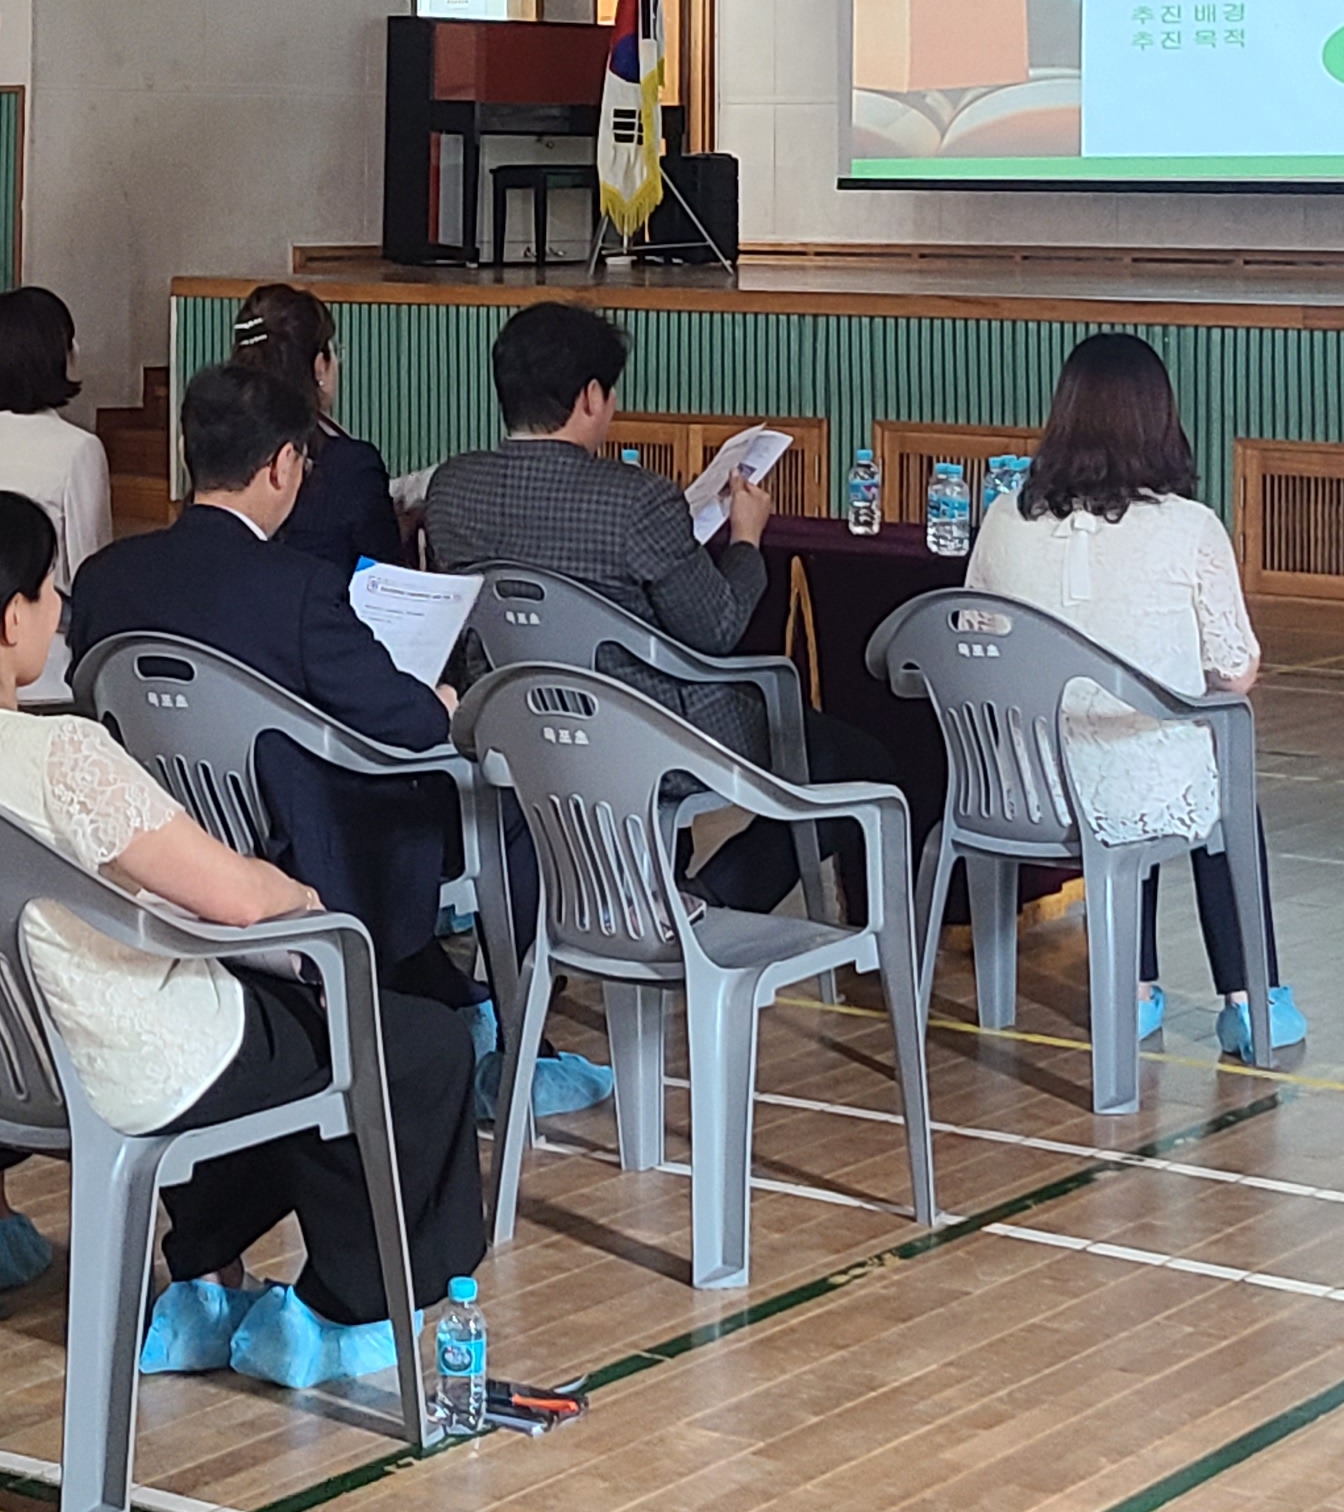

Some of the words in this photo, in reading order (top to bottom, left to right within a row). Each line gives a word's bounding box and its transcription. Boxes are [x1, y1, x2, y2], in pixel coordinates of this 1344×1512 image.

[1131, 4, 1182, 24] 추진
[1194, 3, 1246, 23] 배경
[1131, 30, 1182, 51] 추진
[1194, 28, 1246, 48] 목적
